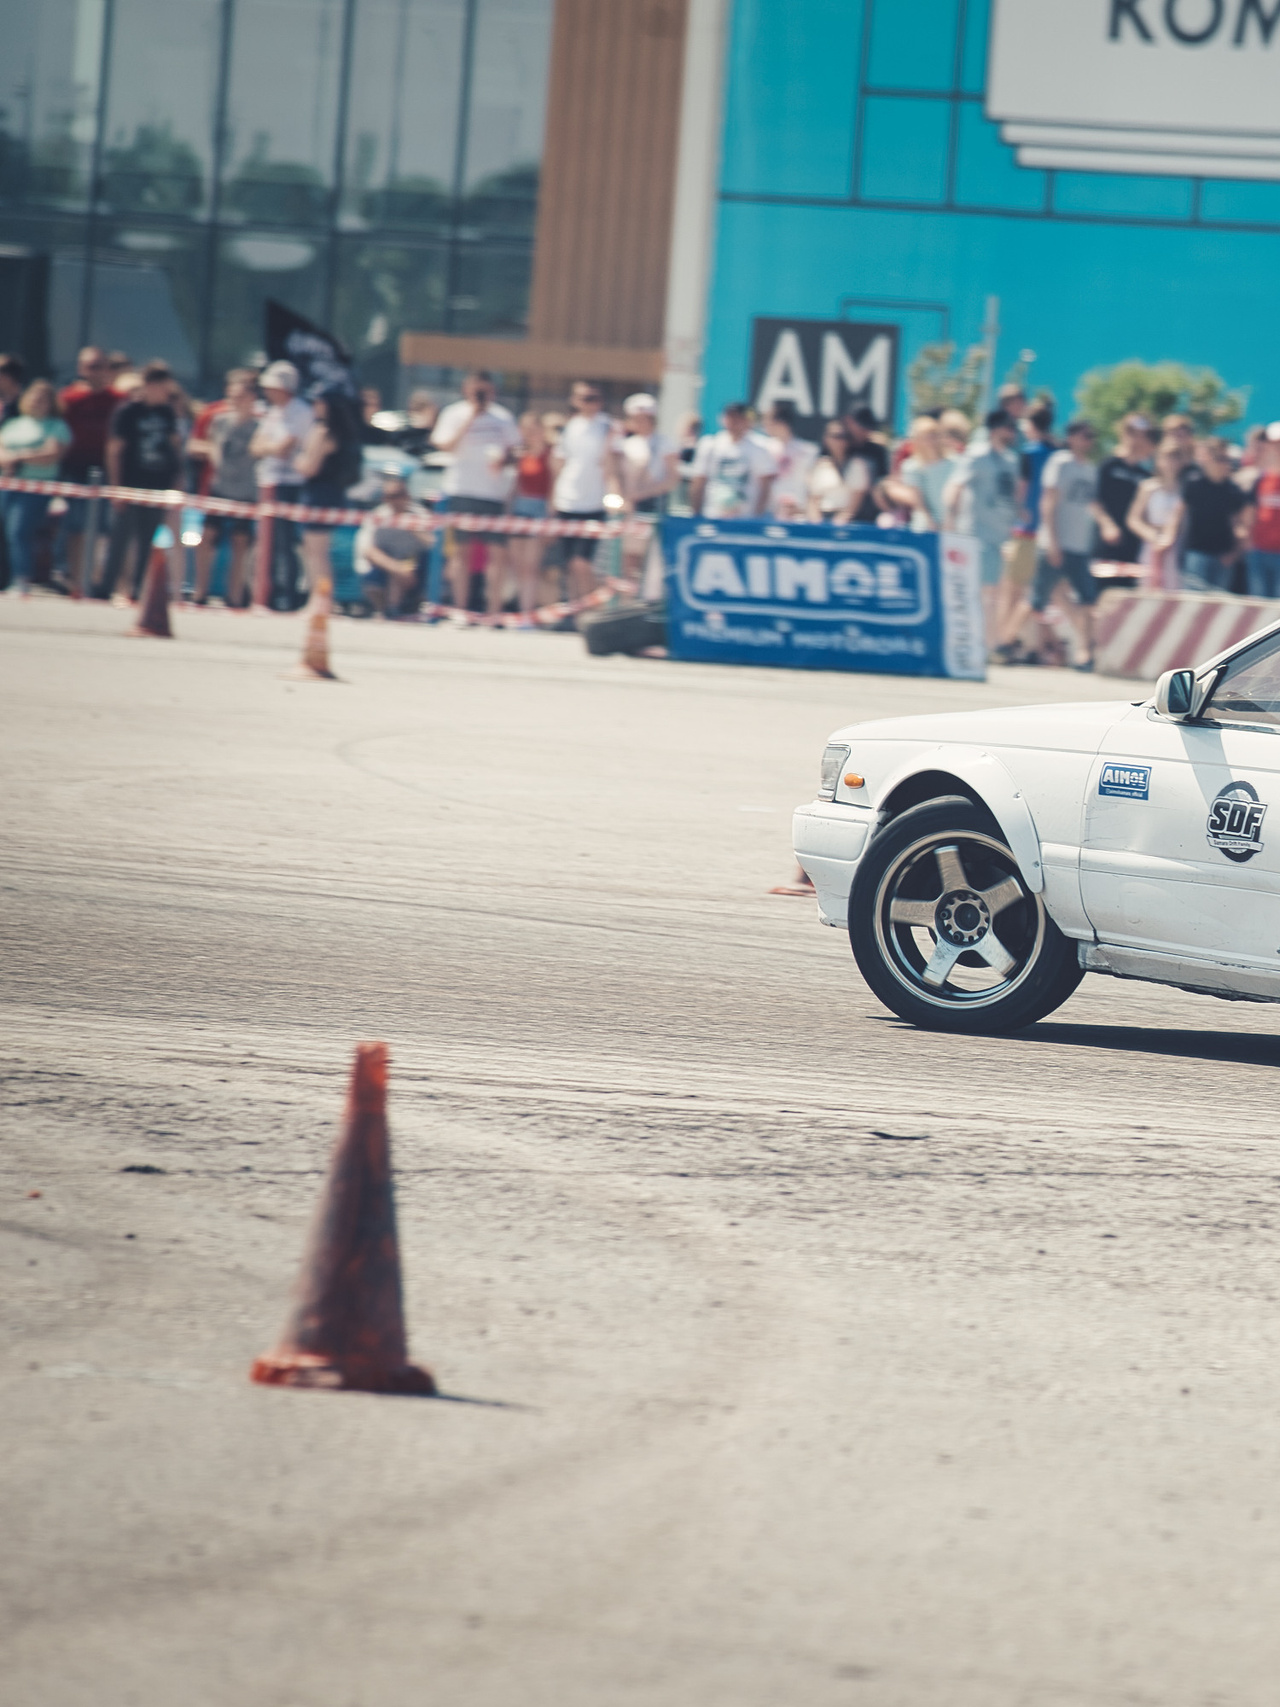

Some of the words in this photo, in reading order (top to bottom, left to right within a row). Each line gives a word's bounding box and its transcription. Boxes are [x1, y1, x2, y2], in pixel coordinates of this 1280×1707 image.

[692, 552, 916, 608] AIMOL
[1103, 769, 1146, 787] AIMOL
[1209, 801, 1264, 837] SDF
